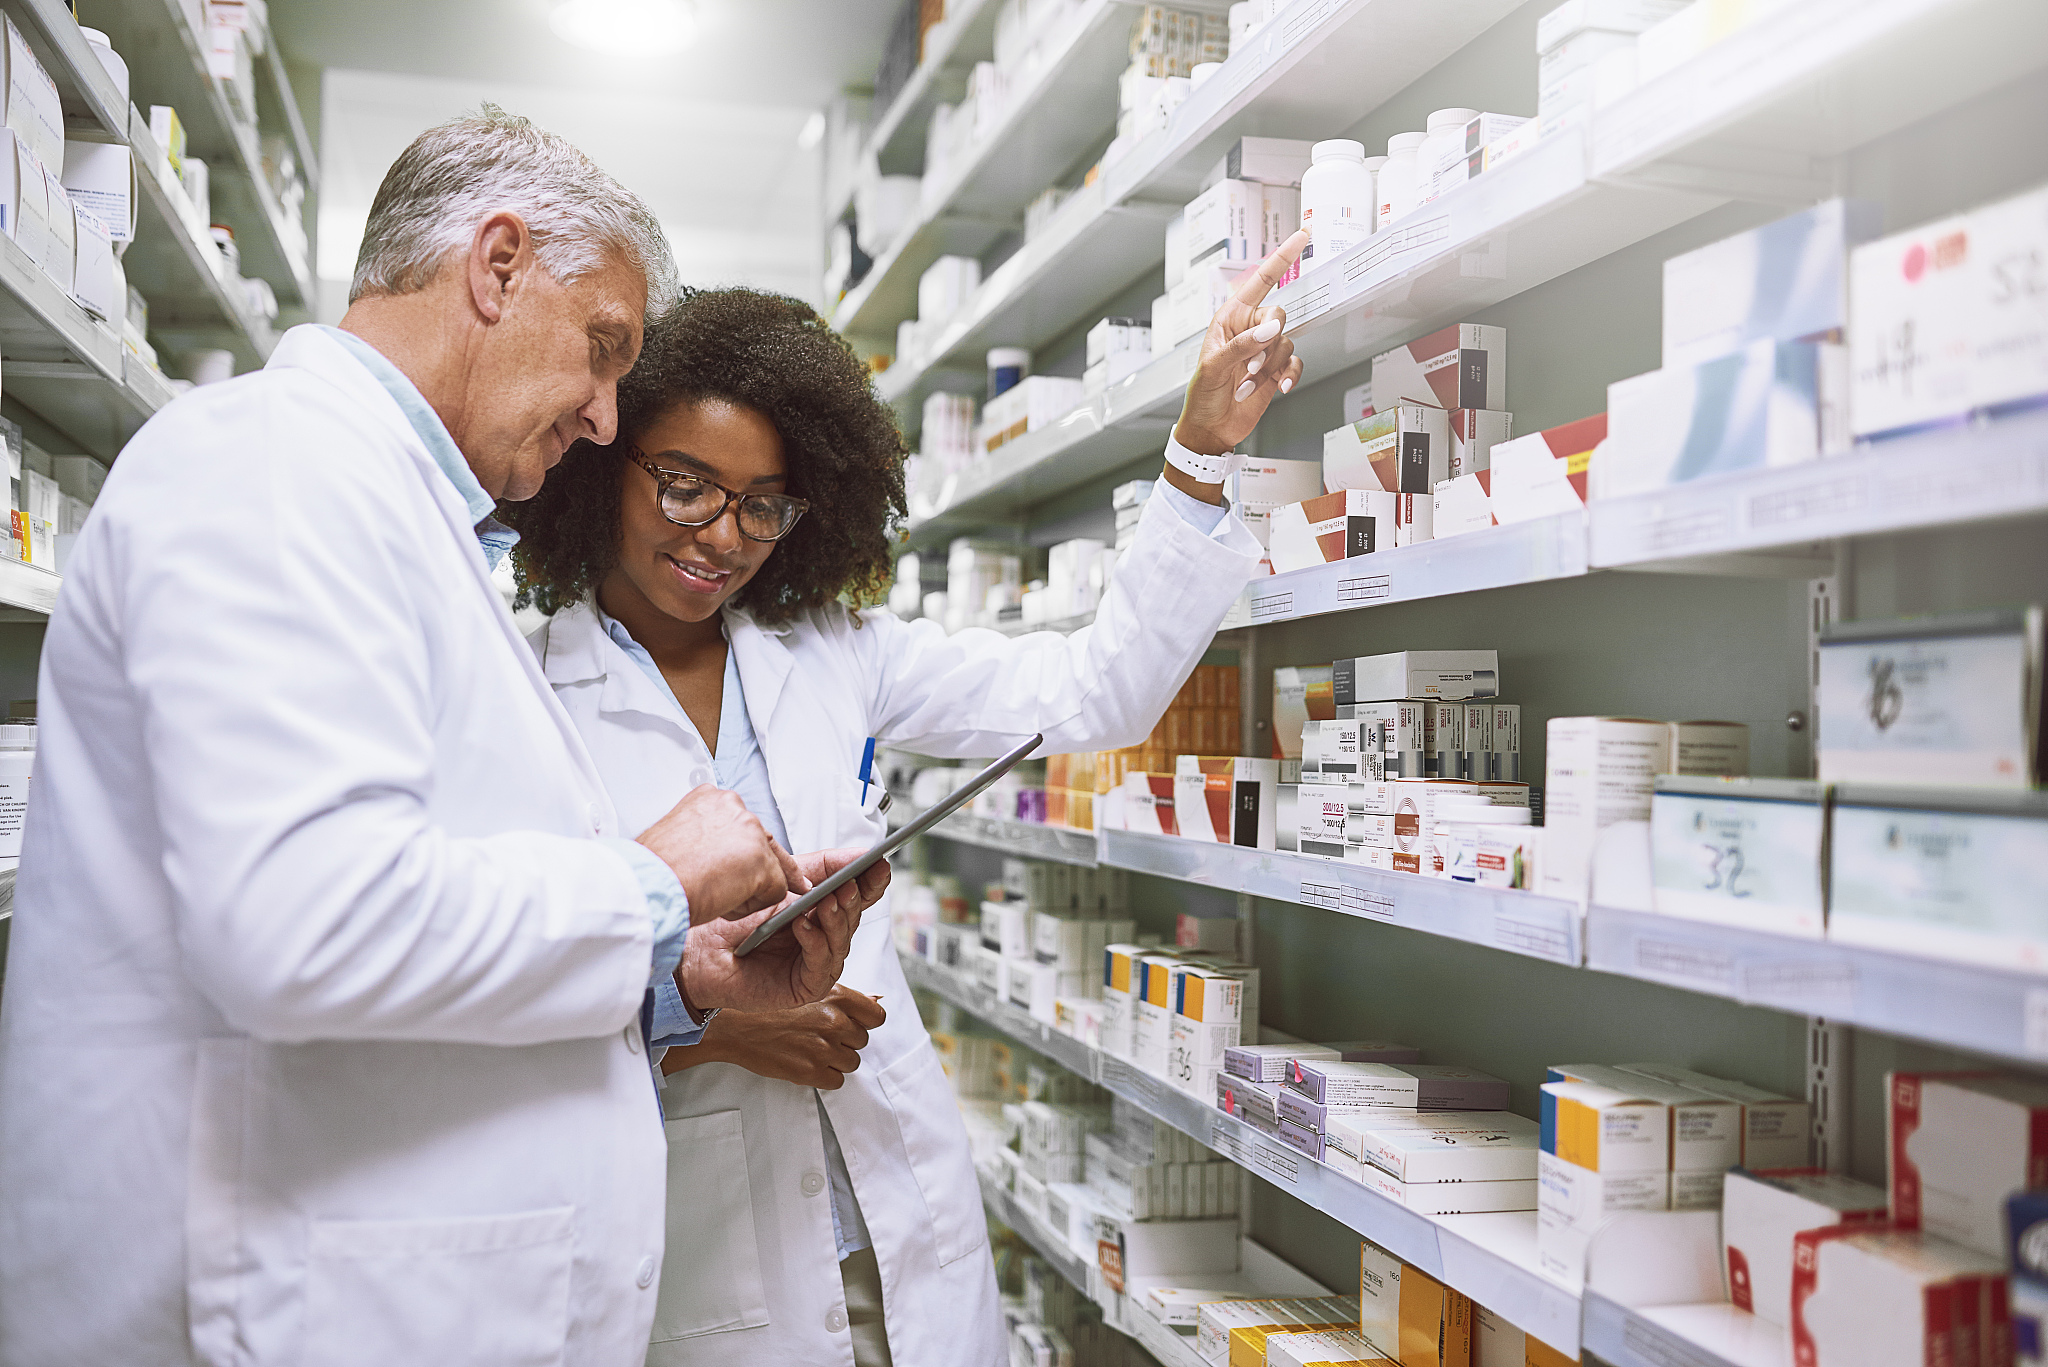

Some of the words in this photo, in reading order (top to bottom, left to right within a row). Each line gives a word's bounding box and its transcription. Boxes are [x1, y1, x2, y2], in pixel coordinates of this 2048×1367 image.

[1322, 802, 1344, 813] 300/12.5
[1701, 844, 1752, 899] 32
[1390, 1270, 1400, 1282] 160
